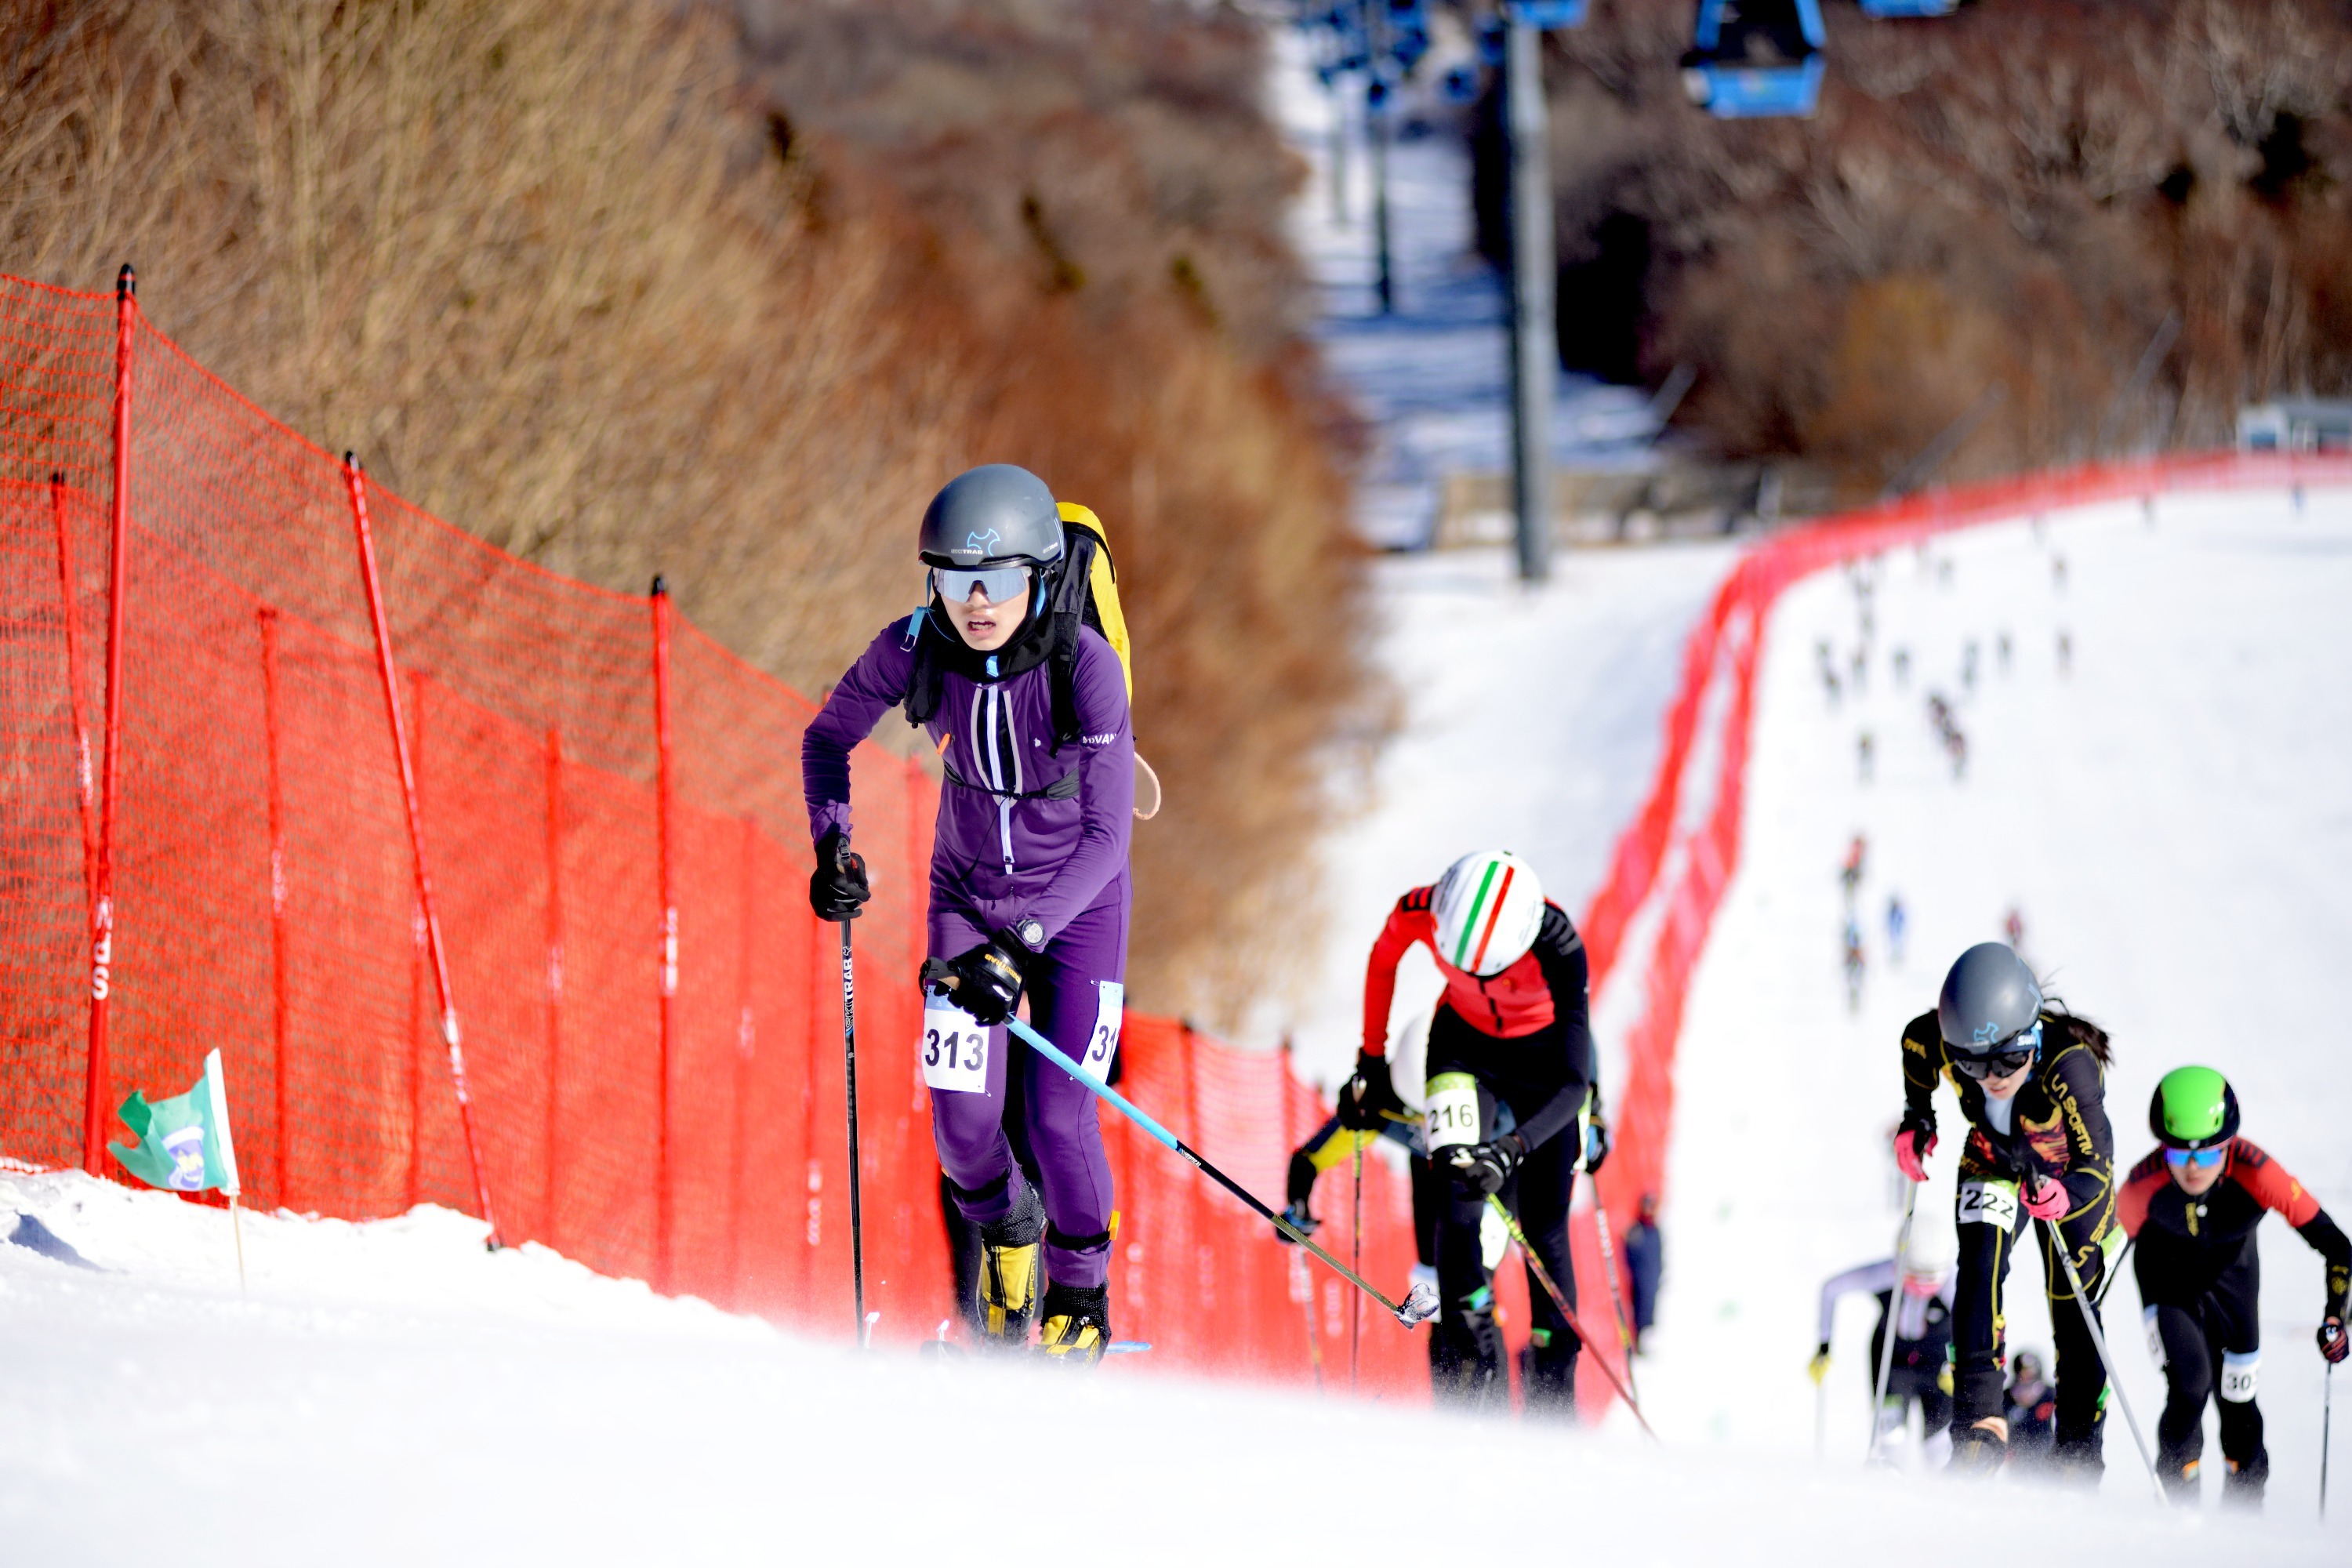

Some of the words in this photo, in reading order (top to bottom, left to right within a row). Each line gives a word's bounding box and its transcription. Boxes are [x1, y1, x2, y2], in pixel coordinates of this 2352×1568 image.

[843, 957, 854, 1029] SKITRAB
[925, 1029, 984, 1072] 313
[1092, 1025, 1120, 1064] 31
[1428, 1104, 1473, 1135] 216
[1964, 1189, 2013, 1219] 222
